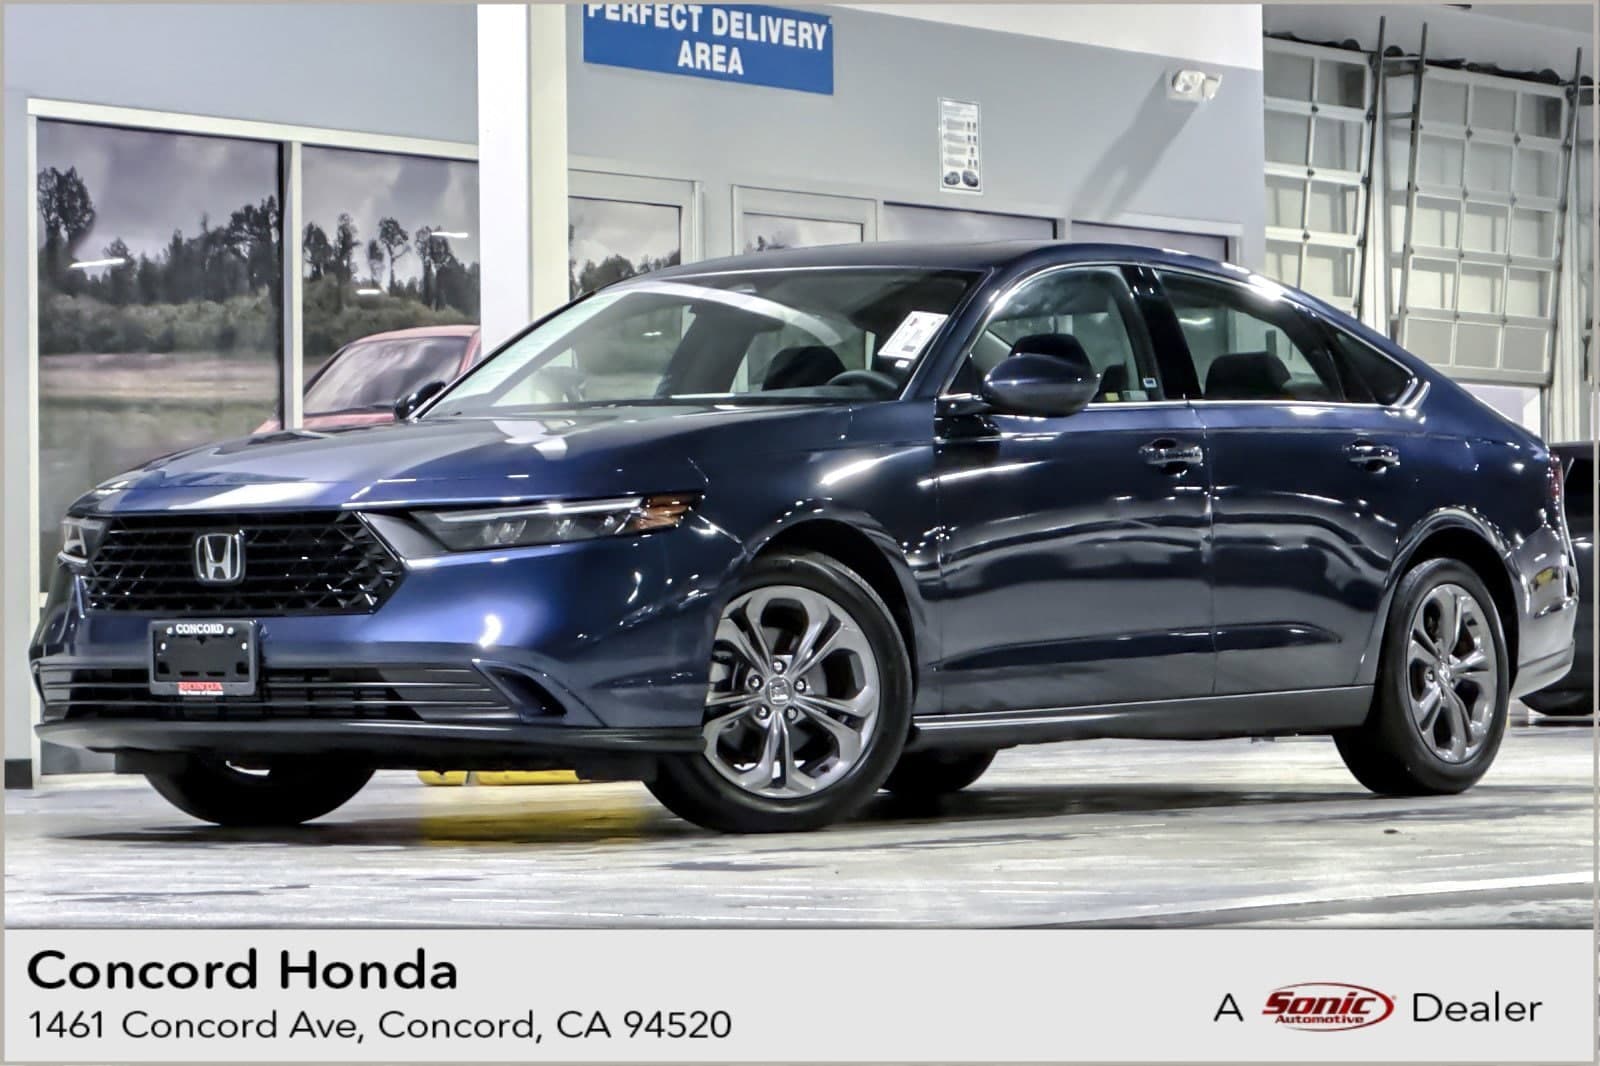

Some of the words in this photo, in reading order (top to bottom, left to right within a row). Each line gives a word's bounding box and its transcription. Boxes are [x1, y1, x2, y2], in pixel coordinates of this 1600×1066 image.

[712, 8, 827, 51] DELIVERY
[678, 40, 744, 76] AREA
[175, 623, 225, 635] CONCORD
